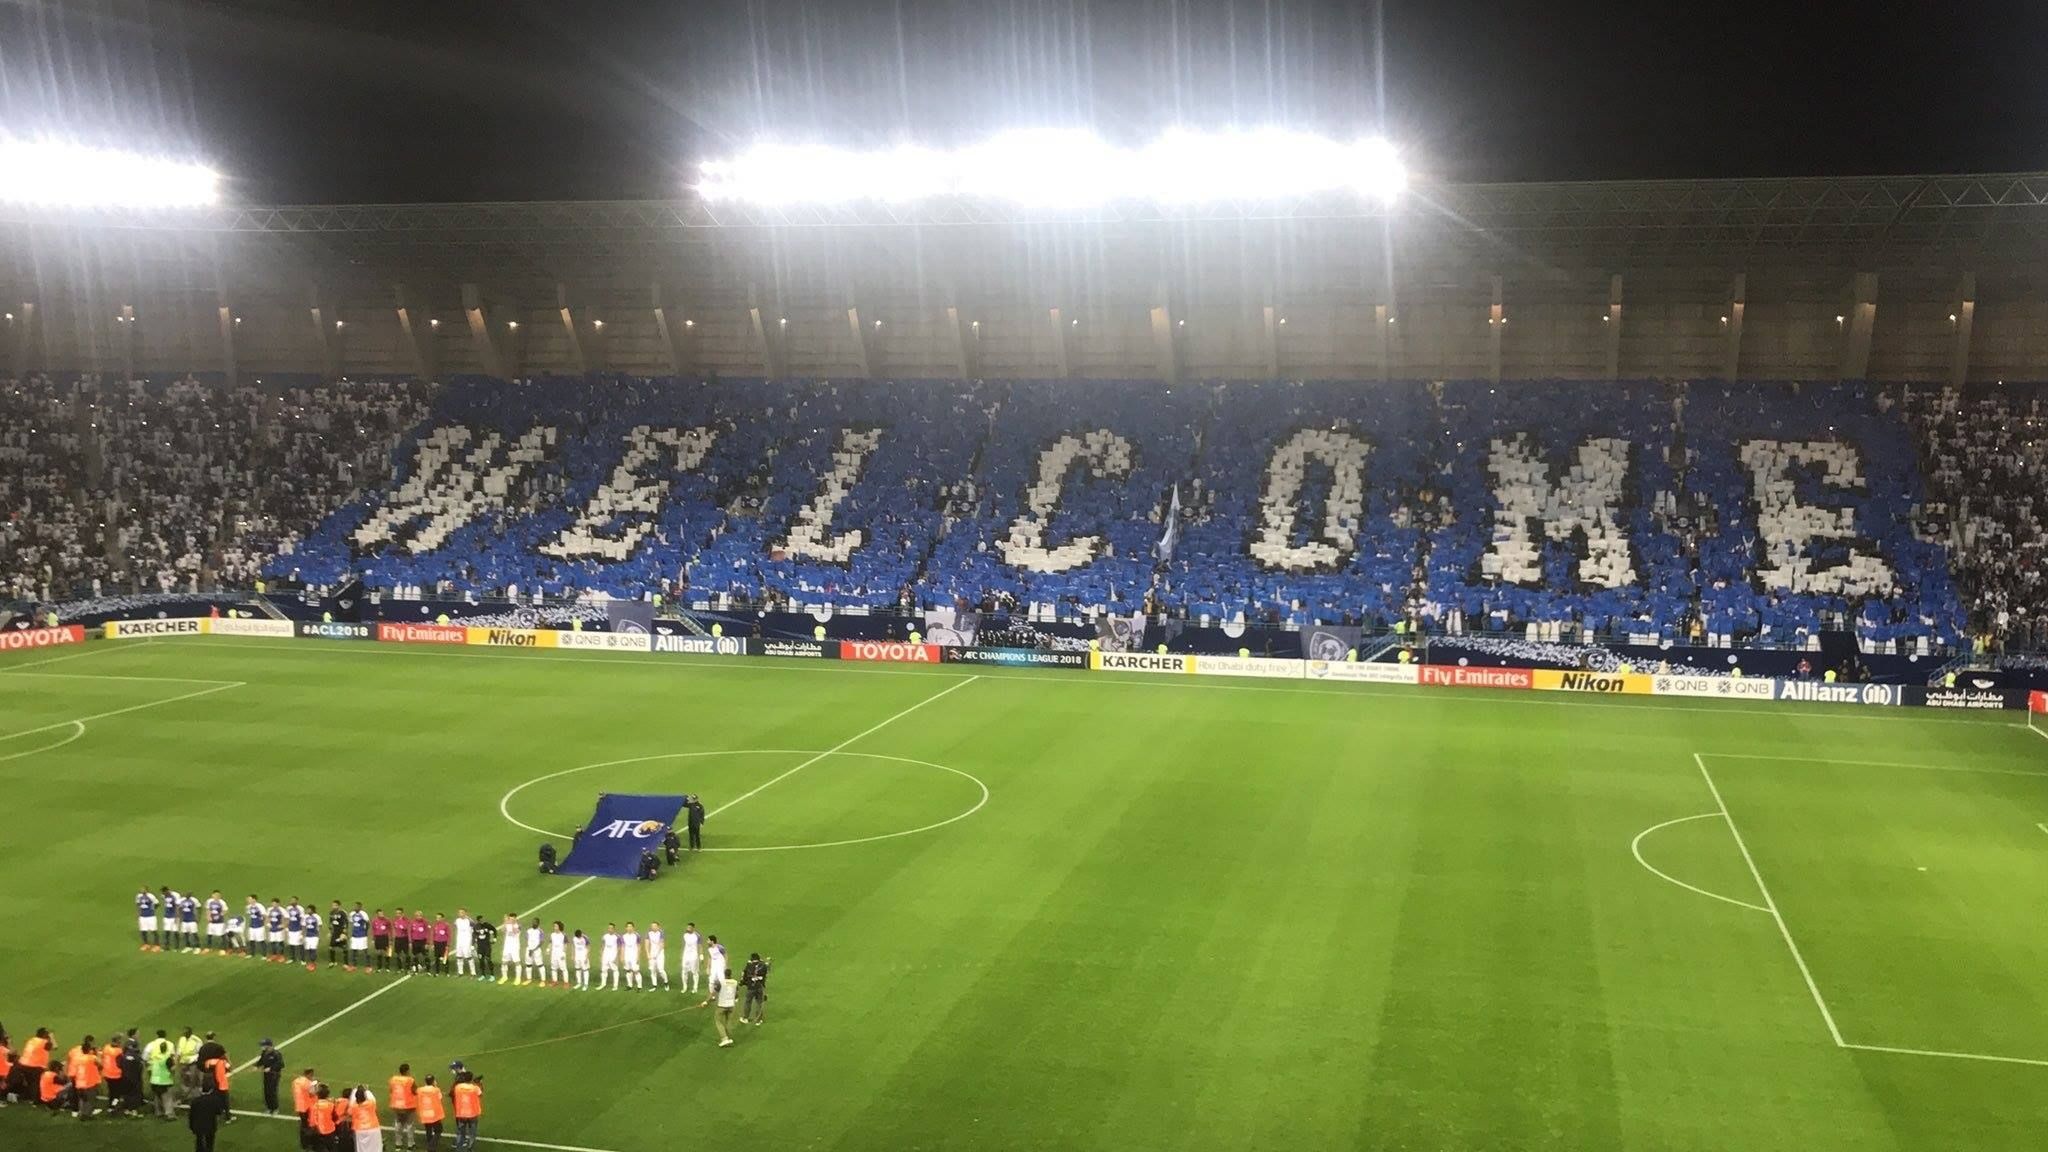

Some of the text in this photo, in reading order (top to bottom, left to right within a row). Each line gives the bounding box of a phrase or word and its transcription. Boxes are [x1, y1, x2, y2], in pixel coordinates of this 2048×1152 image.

[0, 627, 74, 649] TOYOTA
[302, 625, 369, 637] #ACL2018
[383, 626, 464, 642] Fly Emirates
[488, 629, 536, 646] Nikon
[575, 634, 600, 646] QNB
[620, 635, 646, 647] QNB
[655, 635, 714, 653] Allianz
[851, 643, 929, 661] TOYOTA
[963, 651, 1082, 664] AFC CHAMPIONS LEAGUE 2018
[1103, 654, 1183, 670] KÄRCHER
[1423, 667, 1450, 686] Fly
[1455, 668, 1529, 685] Emirates
[1561, 672, 1624, 692] Nikon
[1675, 679, 1708, 691] QNB
[1735, 682, 1769, 694] QNB
[1781, 681, 1857, 702] Allianz
[592, 819, 664, 839] AFC
